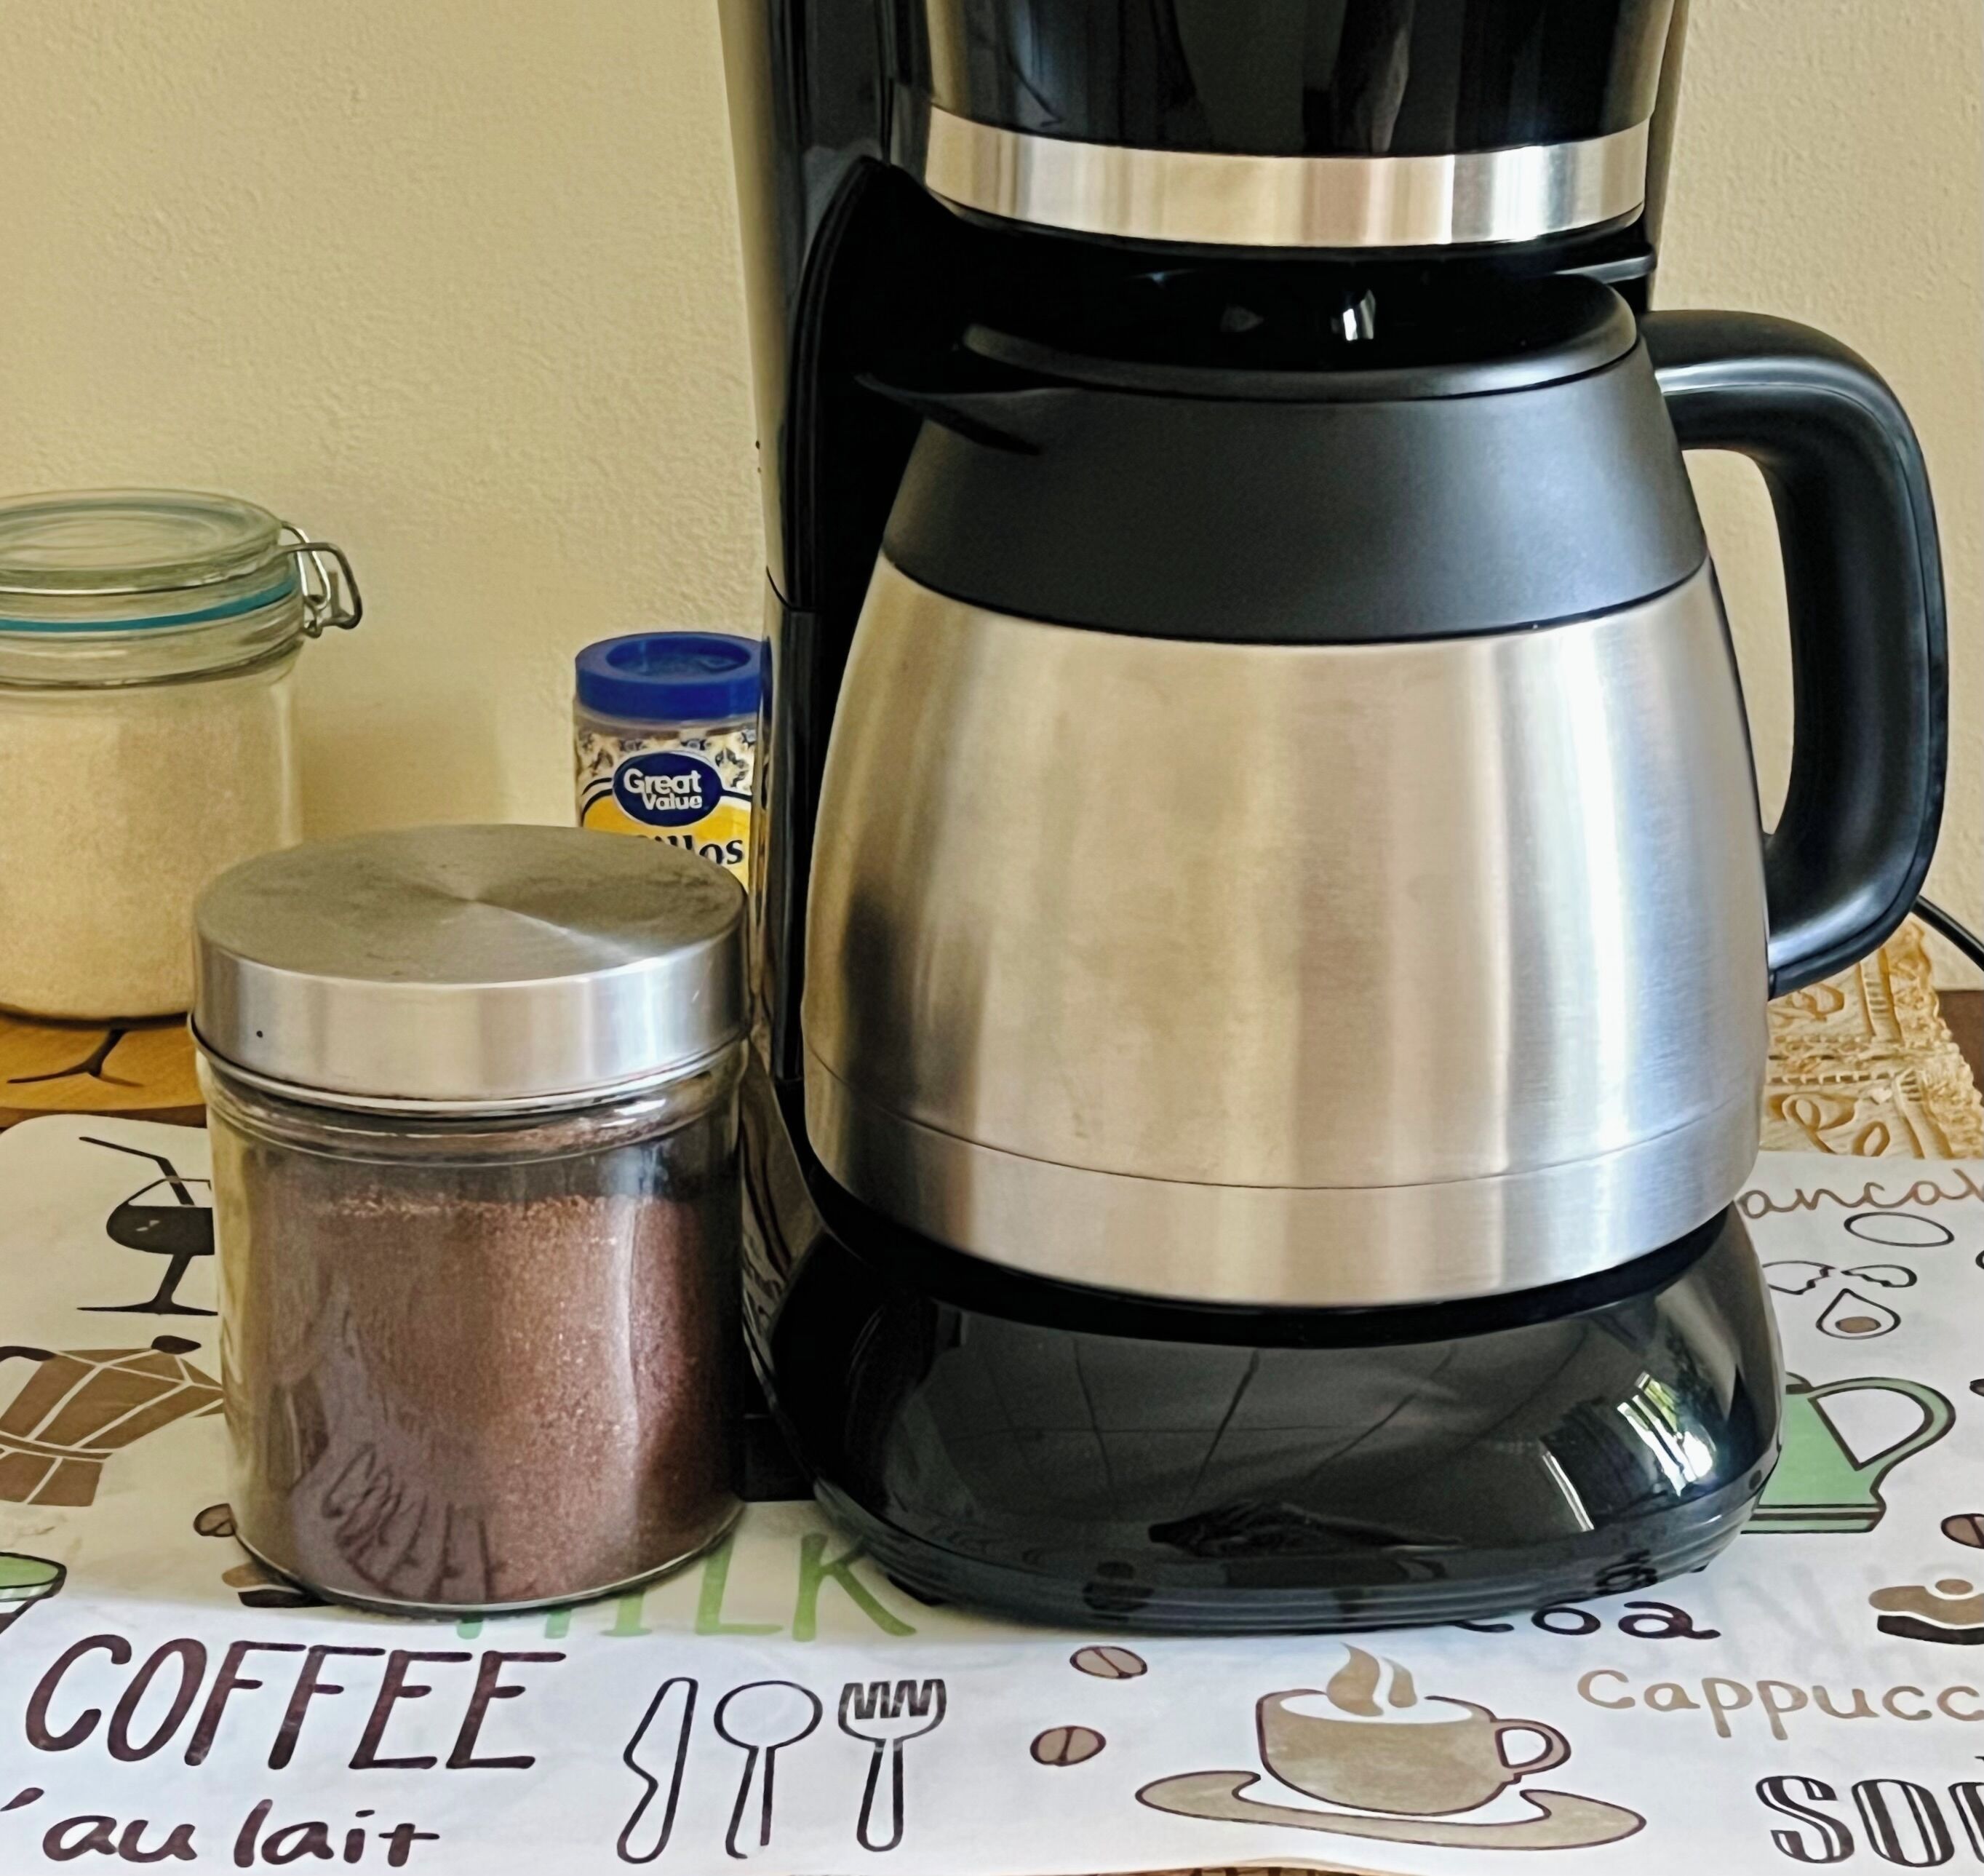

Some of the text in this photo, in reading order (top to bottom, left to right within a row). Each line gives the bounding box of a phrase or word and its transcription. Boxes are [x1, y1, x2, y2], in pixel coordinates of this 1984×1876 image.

[624, 768, 701, 793] Great
[642, 792, 702, 810] Value
[25, 1634, 567, 1770] COFFEE
[234, 1799, 440, 1868] lait
